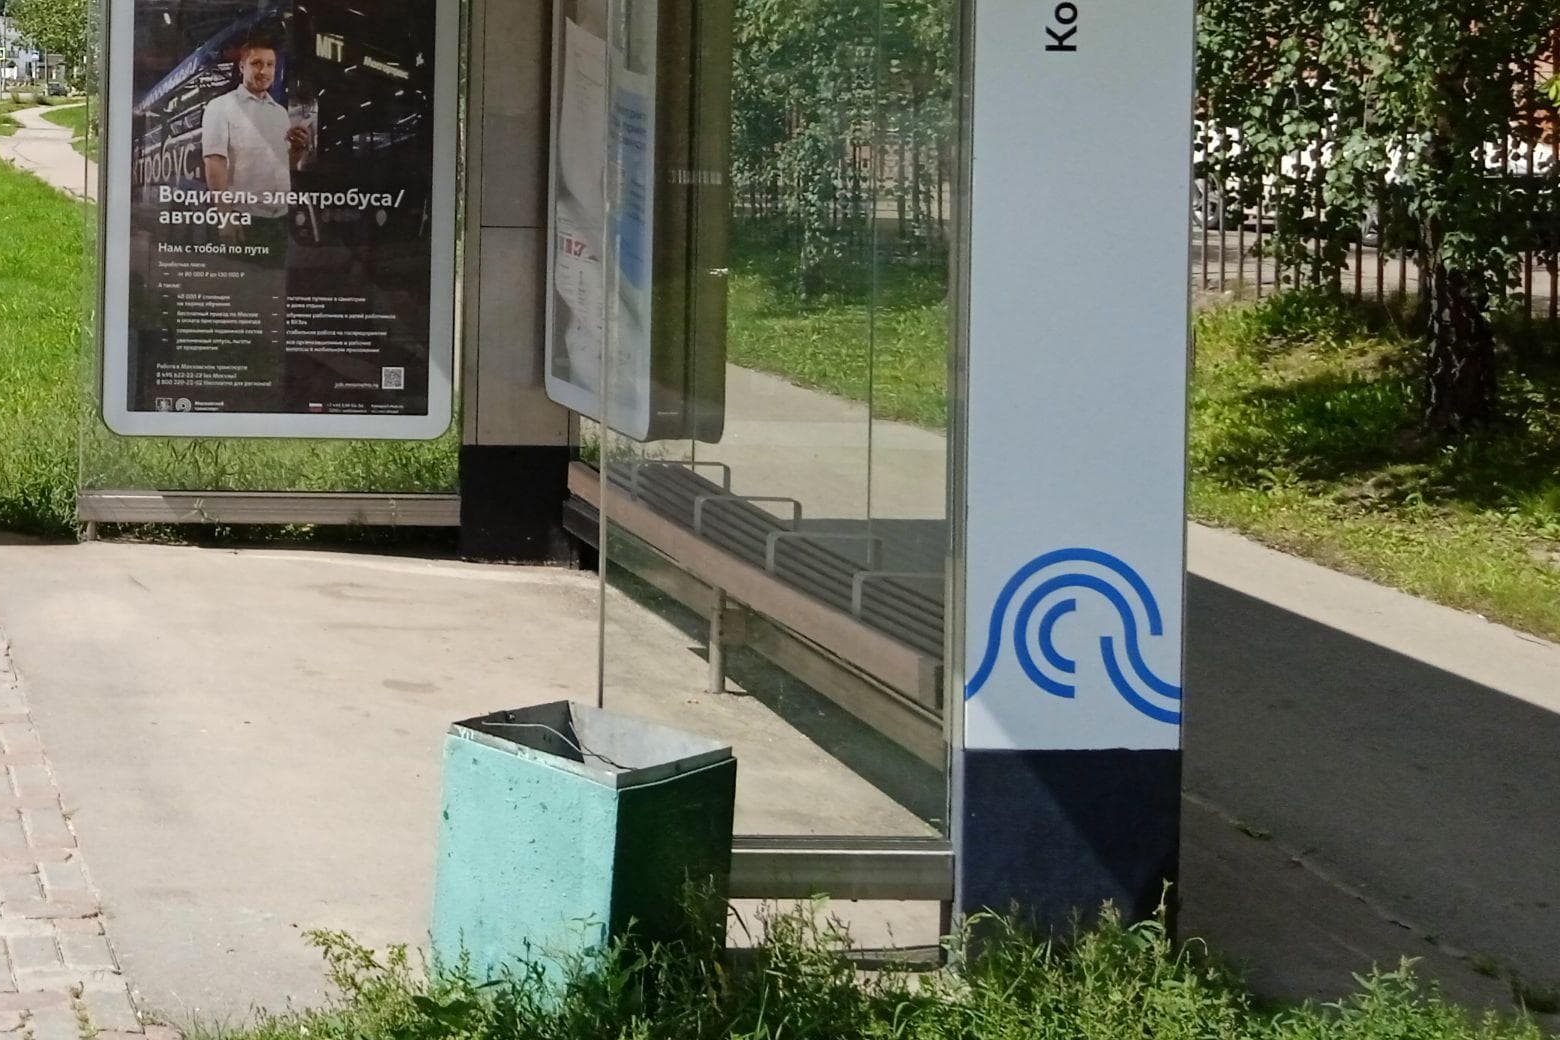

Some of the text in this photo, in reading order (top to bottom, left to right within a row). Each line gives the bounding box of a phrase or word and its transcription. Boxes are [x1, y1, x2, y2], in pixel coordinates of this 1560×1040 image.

[158, 185, 405, 210] Водитель электробуса/
[158, 207, 252, 229] автобуса
[158, 241, 270, 256] Нам с тобой по пути
